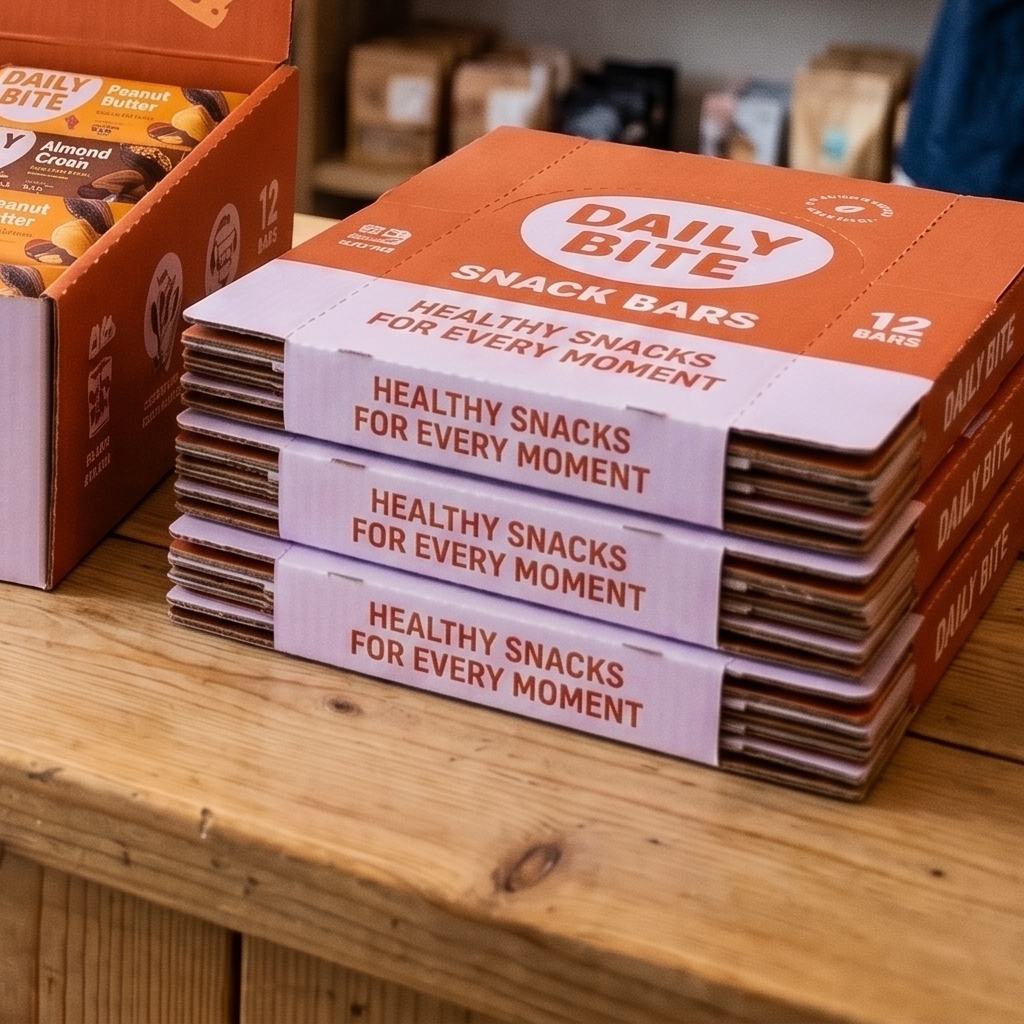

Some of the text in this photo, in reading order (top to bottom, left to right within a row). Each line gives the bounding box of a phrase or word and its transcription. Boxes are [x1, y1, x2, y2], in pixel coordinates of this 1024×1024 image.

[2, 70, 93, 93] DAILY
[101, 96, 158, 112] Butter
[107, 84, 171, 102] Peanut
[40, 141, 112, 160] Almond
[259, 179, 279, 230] 12
[566, 202, 804, 258] DAILY
[559, 229, 750, 281] BITE
[451, 263, 761, 331] SNACK BARS
[870, 311, 932, 338] 12
[366, 312, 727, 391] FOR EVERY MOMENT
[407, 299, 717, 369] HEALTHY SNACKS
[852, 328, 922, 348] BARS
[943, 313, 1016, 432] DAILY BITE
[354, 405, 651, 494] FOR EVERY MOMENT
[373, 375, 631, 454] HEALTHY SNACKS
[937, 422, 1014, 552] DAILY BITE
[352, 517, 647, 611] FOR EVERY MOMENT
[371, 487, 628, 572] HEALTHY SNACKS
[934, 522, 1010, 663] DAILY BITE
[350, 629, 644, 728] FOR EVERY MOMENT
[369, 601, 625, 689] HEALTHY SNACKS
